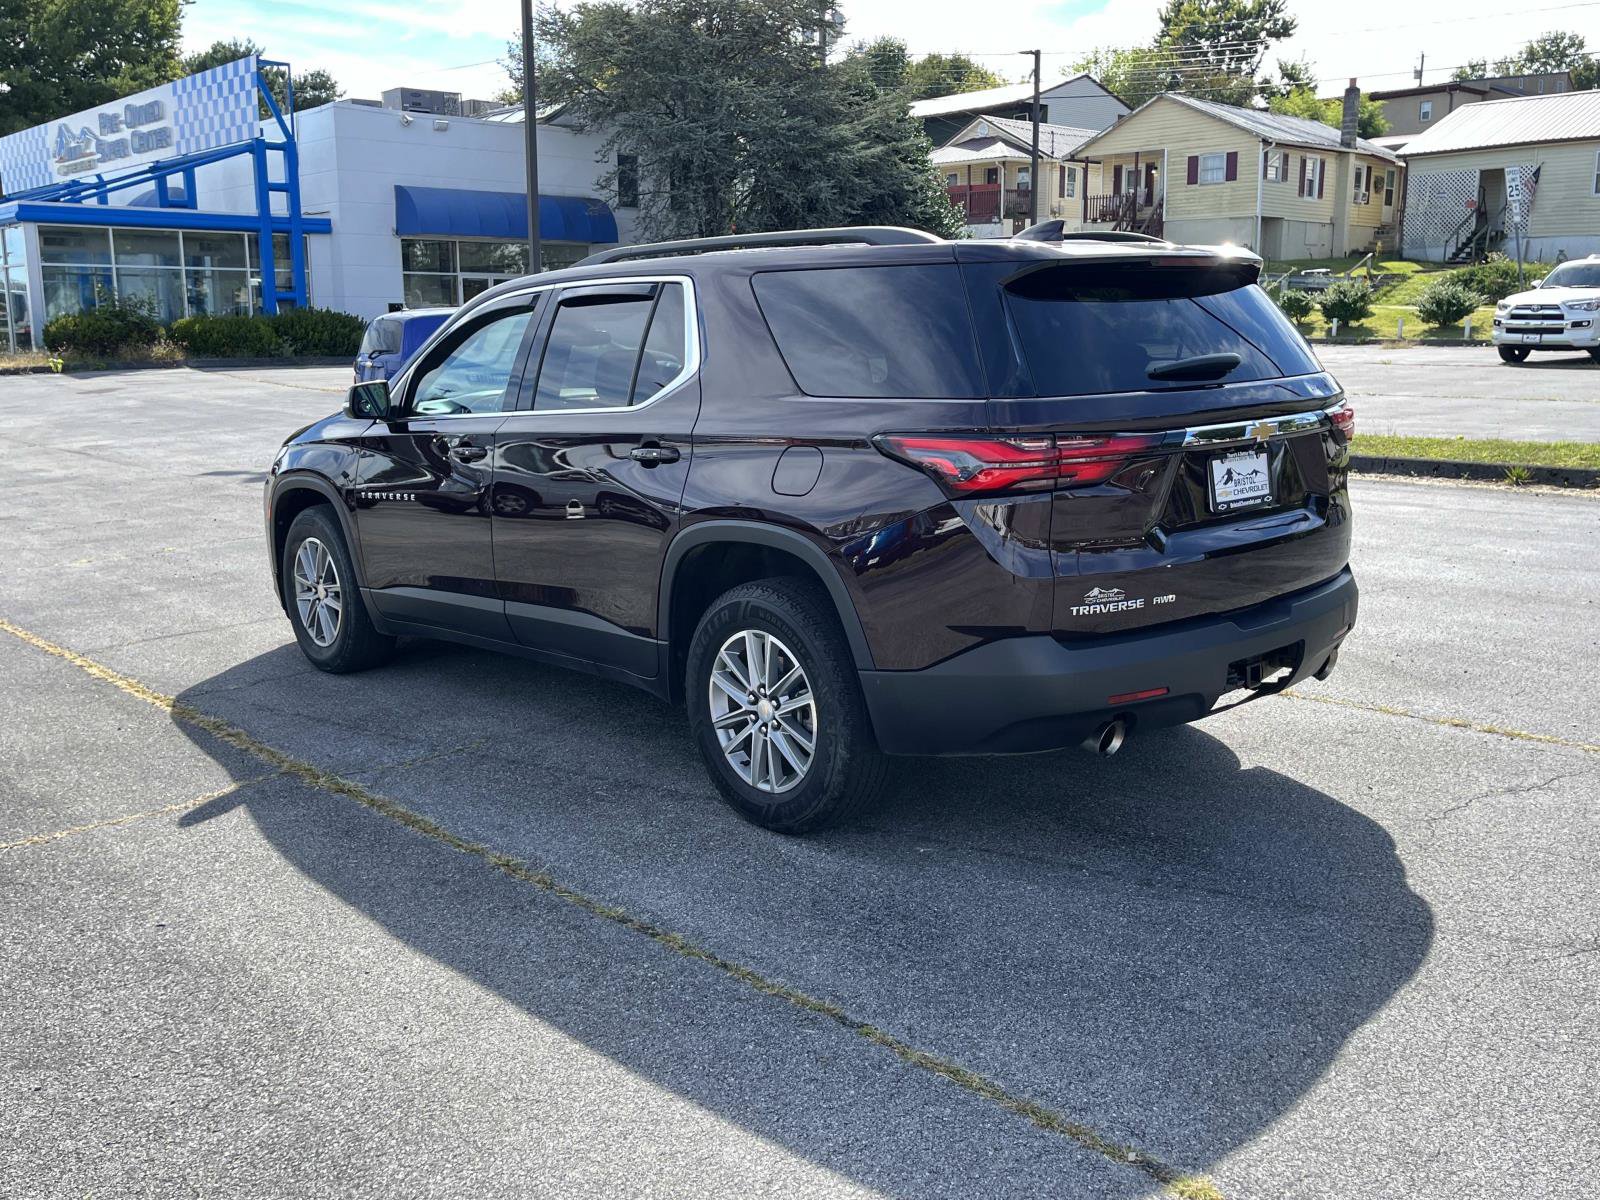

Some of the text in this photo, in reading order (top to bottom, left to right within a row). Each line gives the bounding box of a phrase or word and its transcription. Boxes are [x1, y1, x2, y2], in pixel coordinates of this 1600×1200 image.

[1508, 184, 1521, 198] 25
[1234, 476, 1256, 487] BRISTOL
[1233, 484, 1268, 496] CHEVROLET
[361, 491, 416, 501] TRAVERSE
[1153, 594, 1176, 605] AWD
[1070, 599, 1145, 615] TRAVERSE
